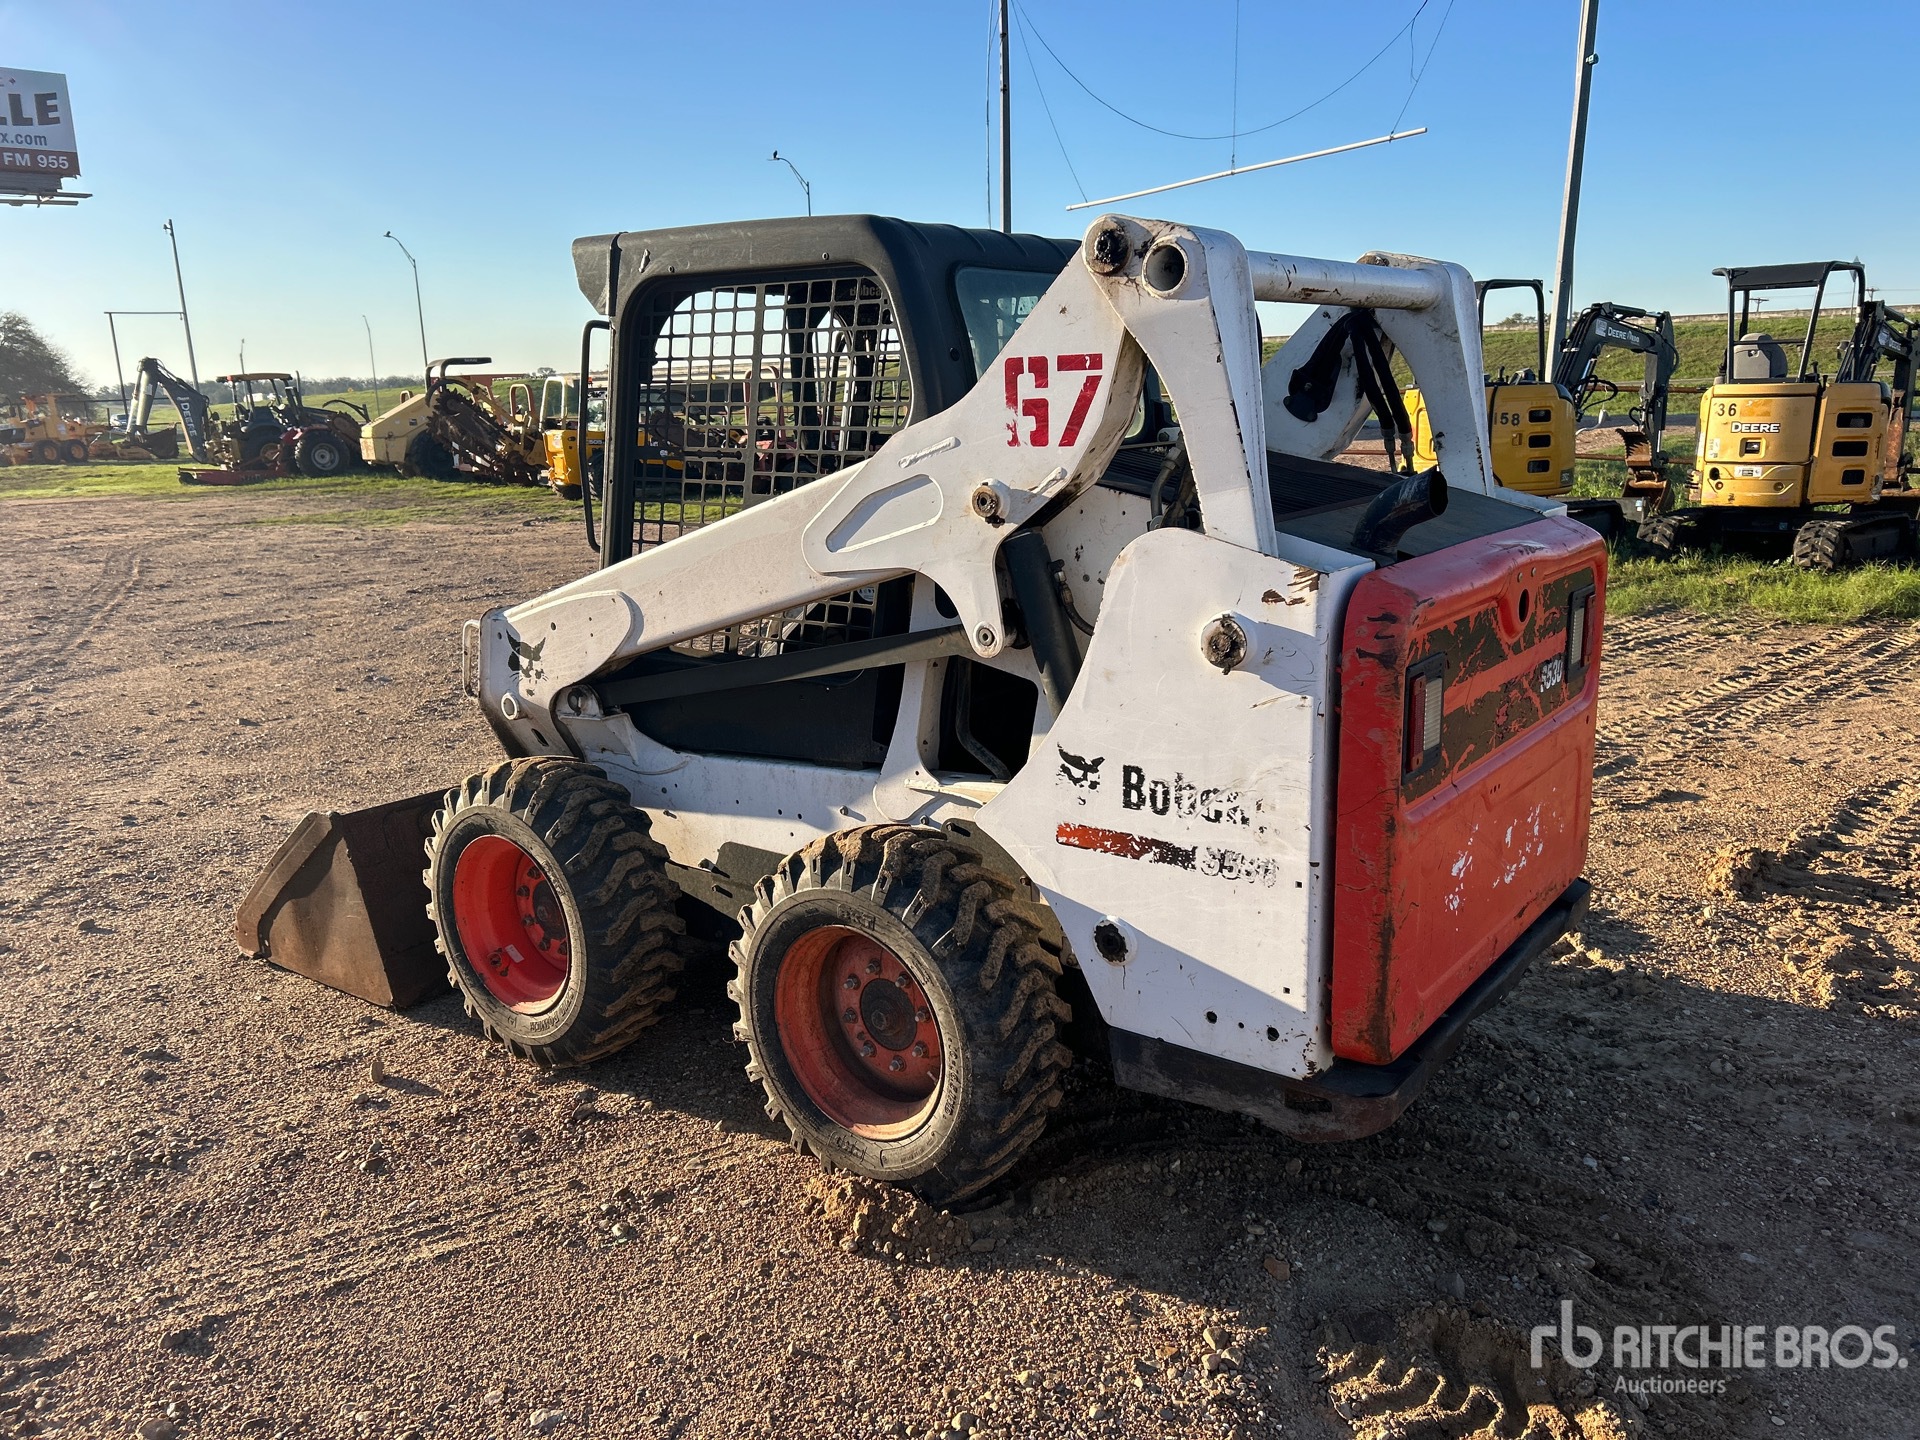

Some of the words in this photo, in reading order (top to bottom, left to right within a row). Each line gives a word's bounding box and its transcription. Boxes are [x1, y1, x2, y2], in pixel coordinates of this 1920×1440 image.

[0, 92, 60, 126] LE
[3, 152, 31, 167] FM
[37, 154, 69, 169] 955
[1004, 353, 1103, 447] 67
[180, 402, 198, 437] DEERE
[1731, 421, 1780, 433] DEERE
[1123, 764, 1266, 836] Bobca
